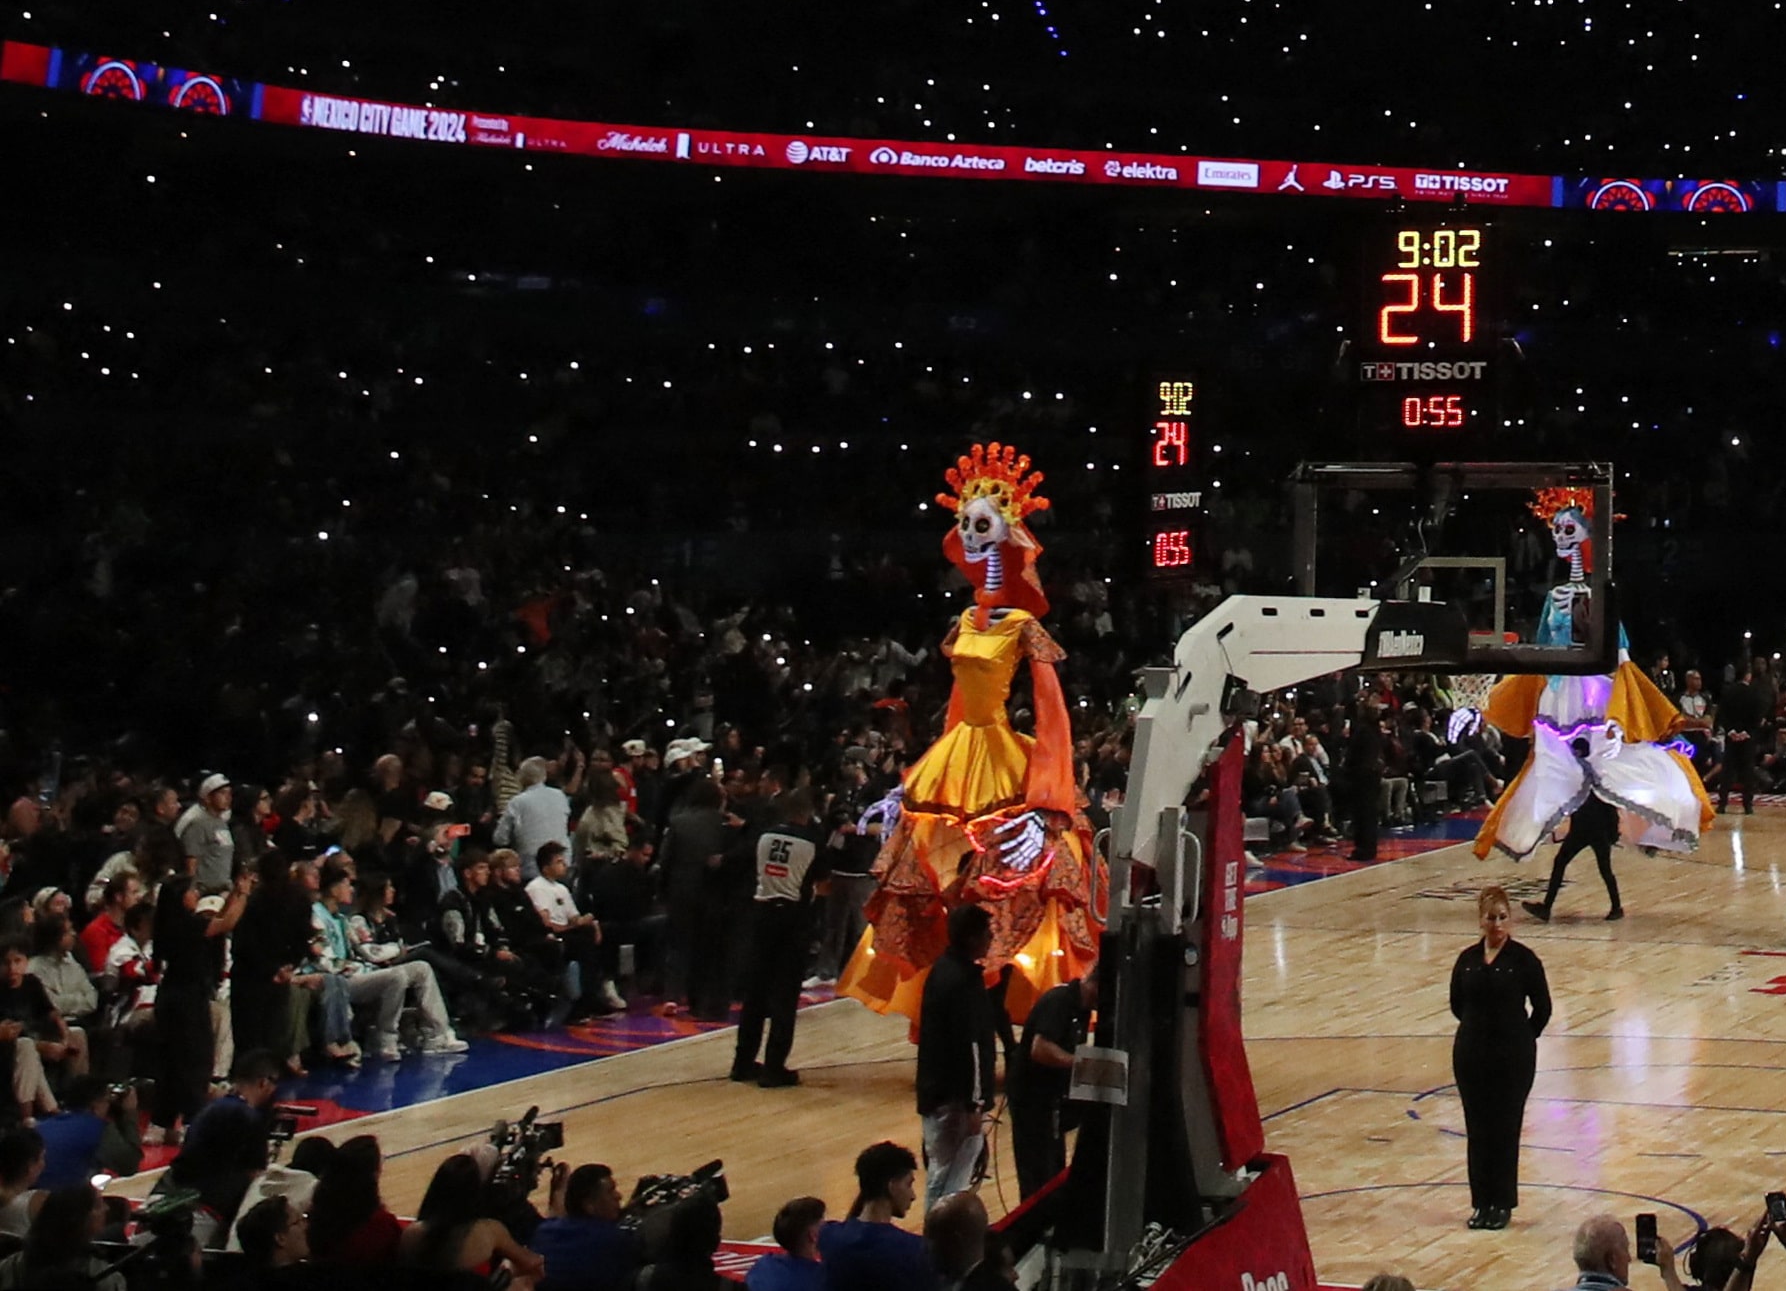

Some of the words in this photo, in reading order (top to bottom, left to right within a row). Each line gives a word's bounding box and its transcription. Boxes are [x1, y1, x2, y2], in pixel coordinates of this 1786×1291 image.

[312, 96, 359, 131] MEXICO
[360, 102, 391, 135] CITY
[391, 106, 428, 139] GAME
[428, 112, 466, 143] 2024
[597, 131, 668, 153] Michelob
[698, 143, 765, 156] ULTRA
[809, 145, 853, 162] AT&T
[900, 152, 949, 168] Banco
[950, 154, 1004, 170] Azteca
[1024, 157, 1084, 174] betcris
[1122, 162, 1177, 180] elektra
[1348, 174, 1397, 190] PS5
[1444, 175, 1508, 193] TISSOT
[1398, 230, 1480, 268] 9:02
[1381, 273, 1471, 344] 24
[1396, 362, 1487, 380] TISSOT
[1405, 397, 1462, 426] 0:55
[1155, 422, 1186, 466] 24
[1167, 492, 1201, 509] TISSOT
[769, 839, 794, 863] 25
